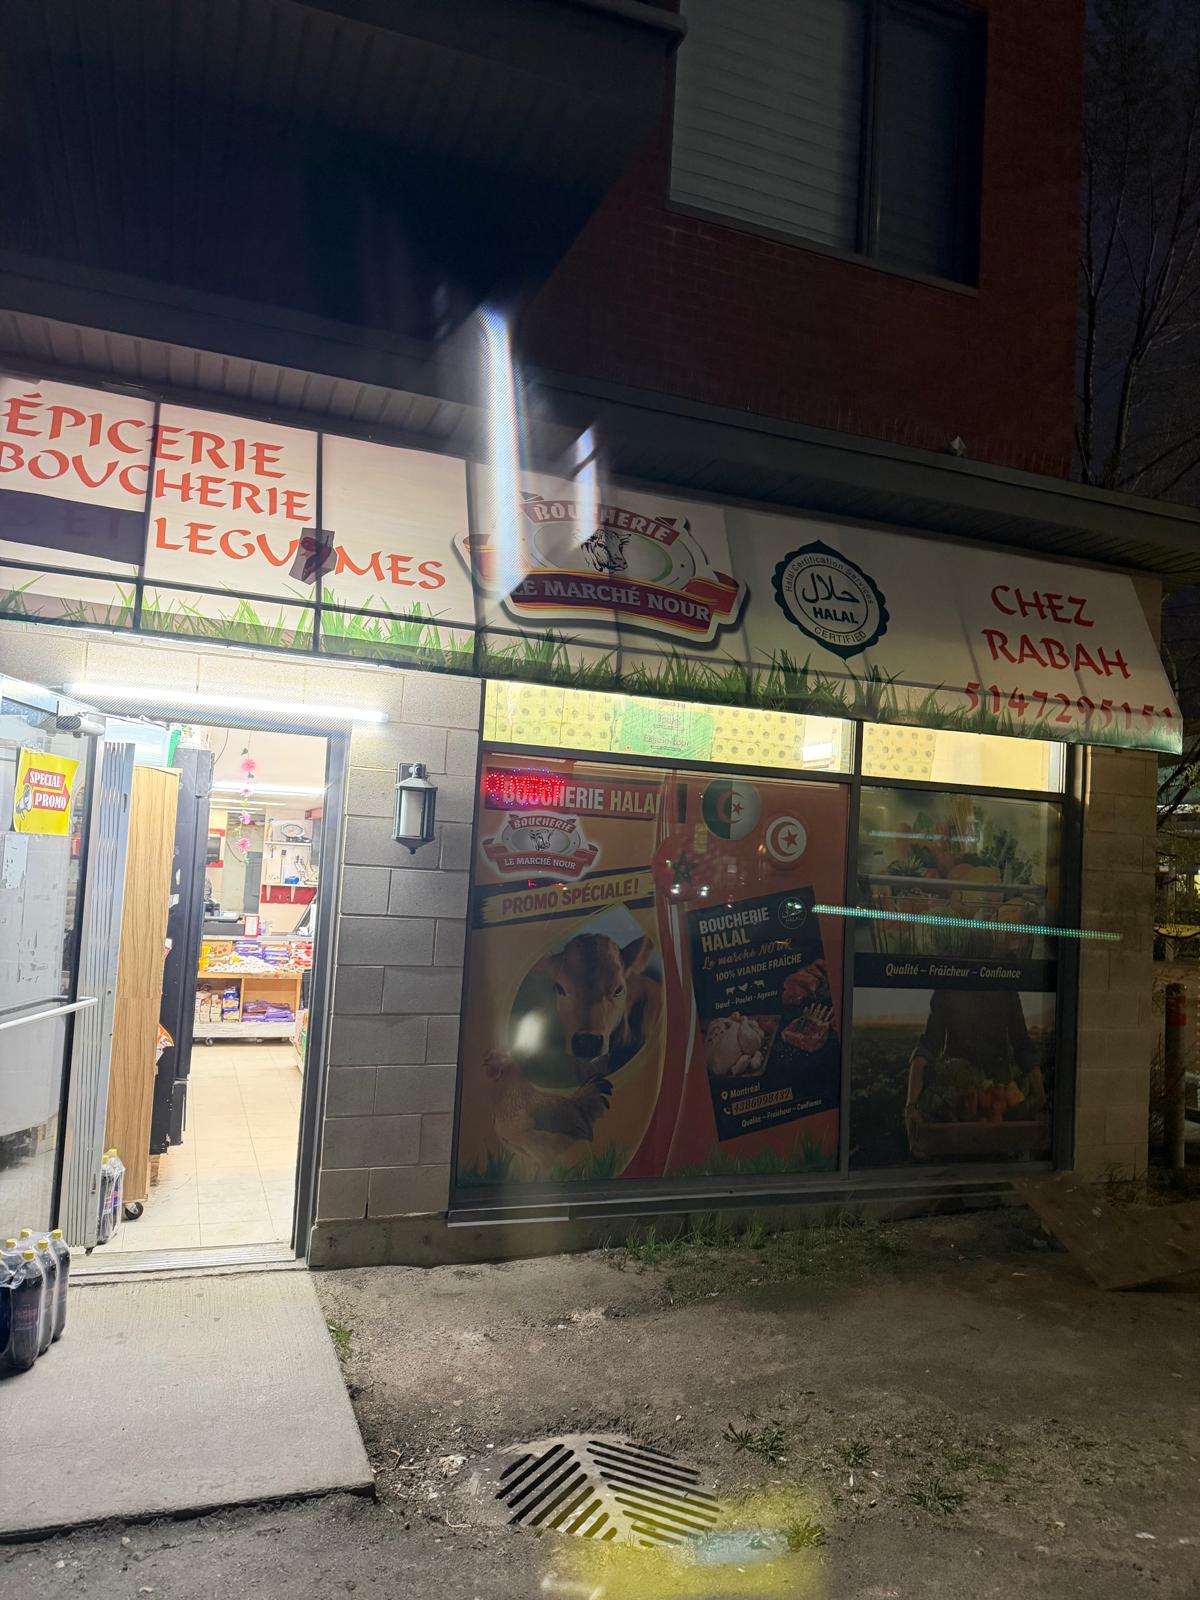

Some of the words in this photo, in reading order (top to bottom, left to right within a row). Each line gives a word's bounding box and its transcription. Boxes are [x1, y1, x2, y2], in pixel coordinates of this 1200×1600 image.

[2, 393, 285, 479] ÉPICERIE
[0, 442, 312, 521] BOUCHERIE
[534, 503, 671, 540] BOUHERIE
[511, 579, 538, 597] LE
[544, 580, 641, 606] MARCHÉ
[647, 593, 710, 622] NOUR
[802, 573, 860, 603] حلال
[812, 606, 859, 624] HALAL
[990, 584, 1094, 627] CHEZ
[814, 626, 866, 643] CERTIFIED
[981, 629, 1131, 679] RABAH
[29, 770, 61, 787] SPECIAL
[485, 773, 566, 798] OUVERT
[34, 792, 66, 810] PROMO
[513, 816, 573, 832] BOUCHERIE
[504, 858, 514, 866] LE
[517, 856, 551, 867] MARCHÉ
[553, 859, 576, 870] NOUR
[502, 889, 559, 915] PROMO
[699, 907, 769, 934] BOUCHERIE
[702, 929, 750, 952] HALAL
[716, 970, 735, 982] 100%
[737, 963, 767, 976] VIANDE
[885, 963, 918, 977] Qualité
[979, 965, 1021, 979] Confiance
